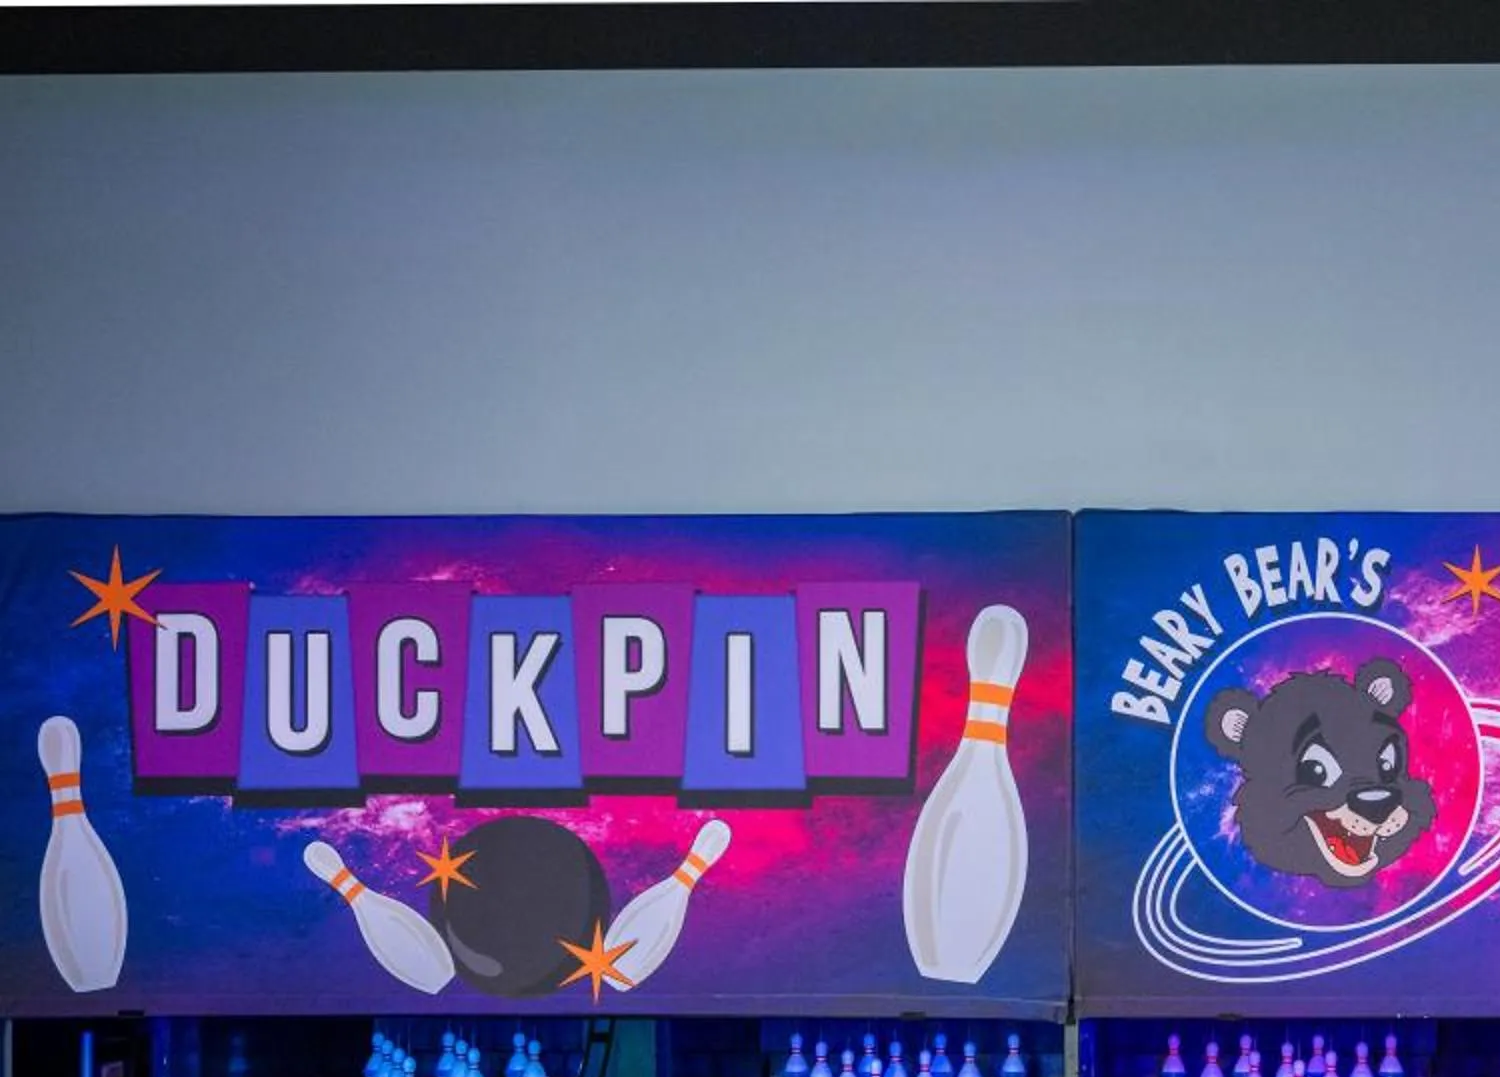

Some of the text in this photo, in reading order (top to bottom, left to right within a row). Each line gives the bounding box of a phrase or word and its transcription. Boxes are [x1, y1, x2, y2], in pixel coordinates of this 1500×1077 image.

[155, 609, 887, 754] DUCKPIN
[1110, 536, 1392, 724] BEARY BEAR'S
